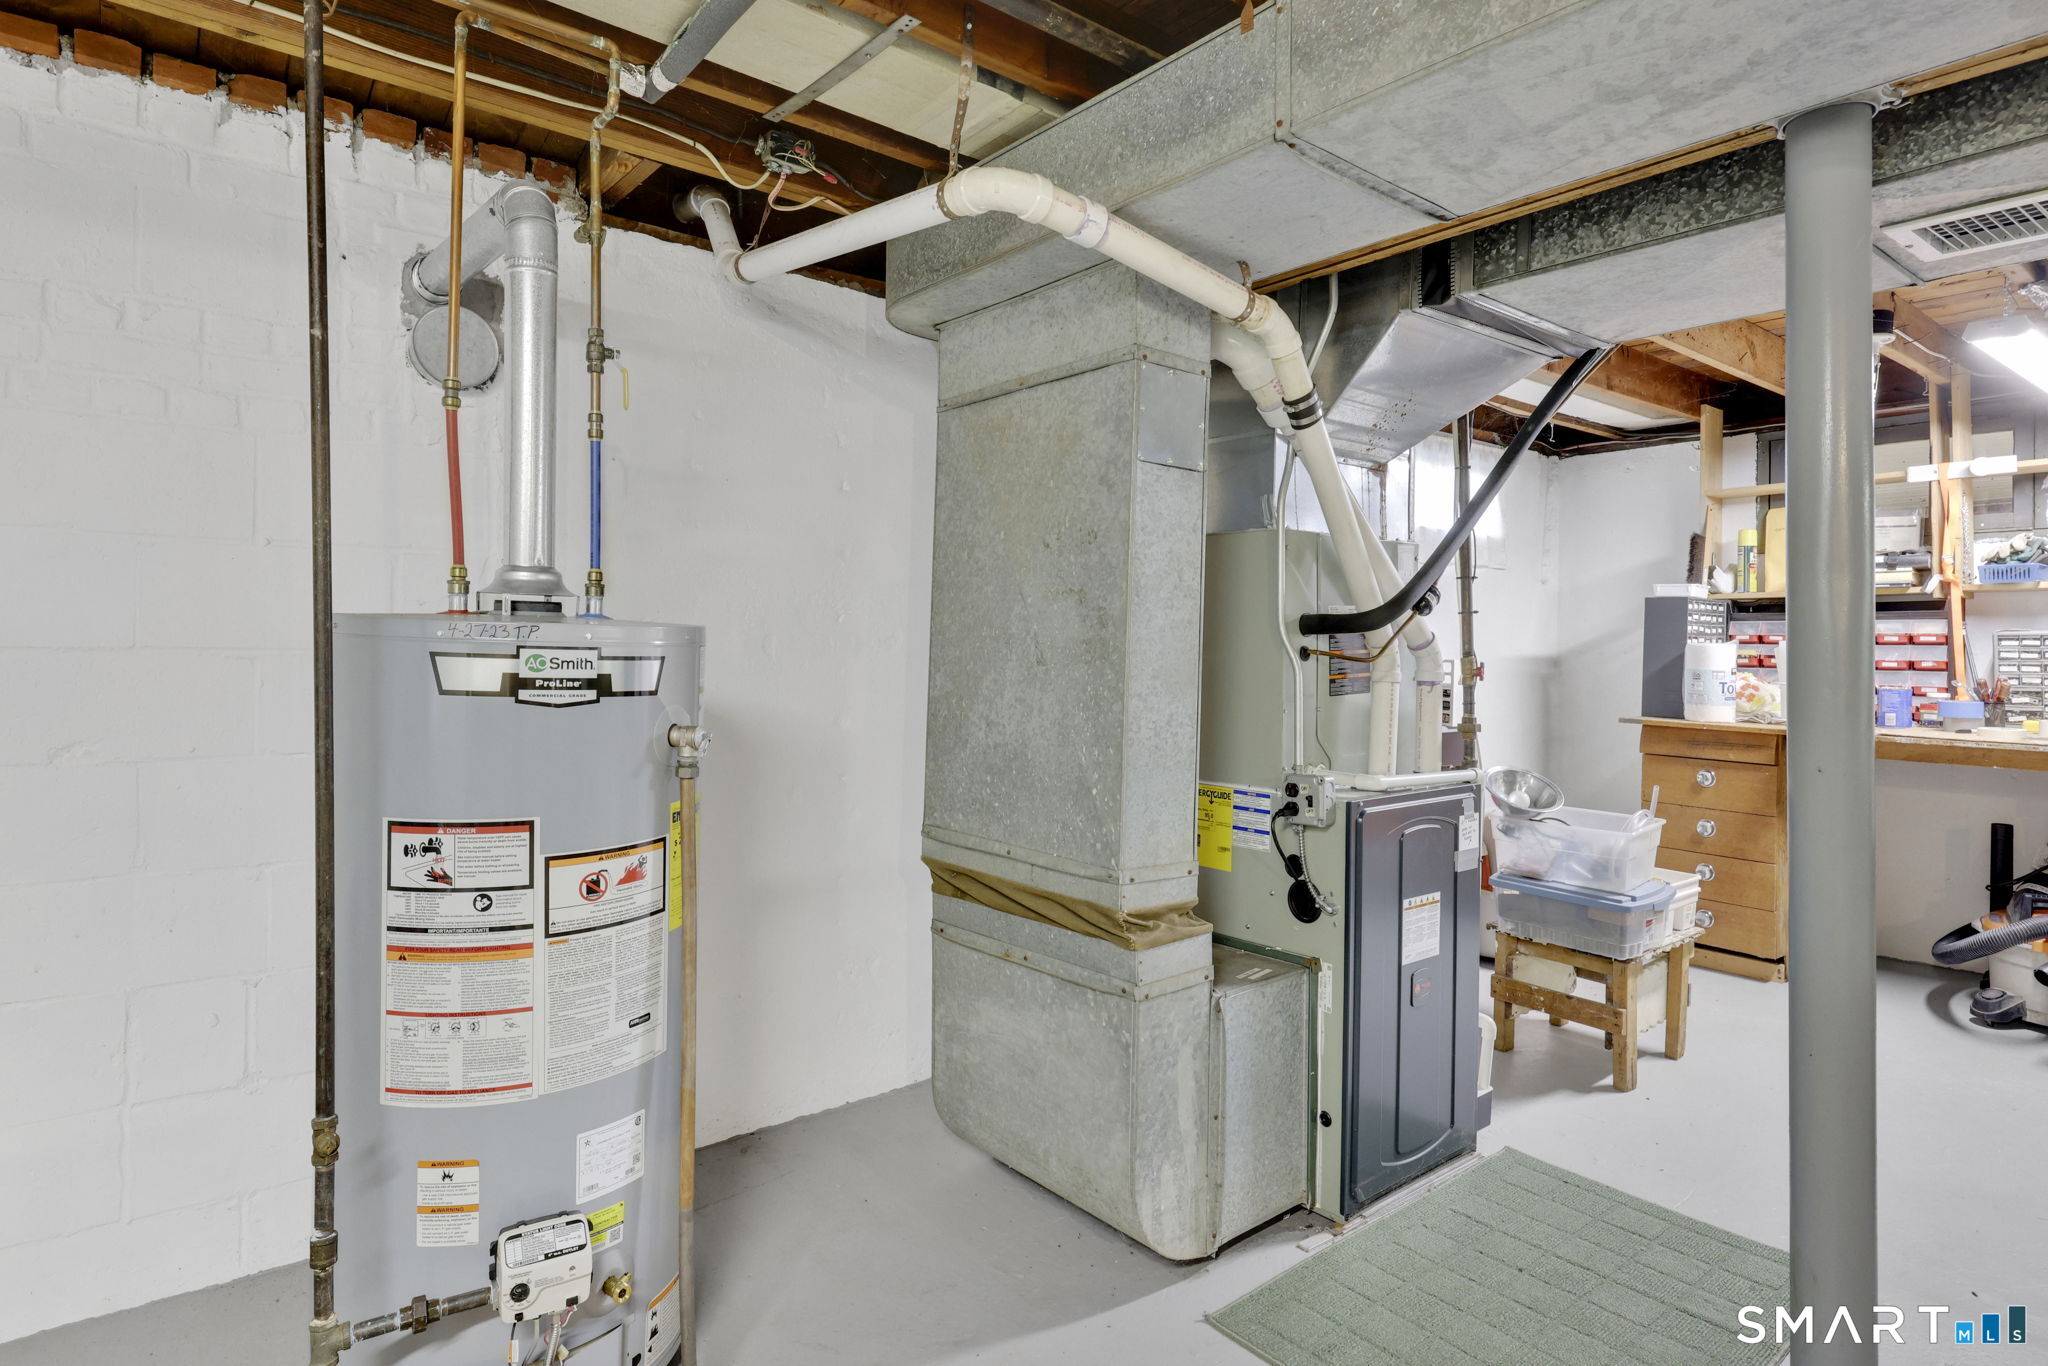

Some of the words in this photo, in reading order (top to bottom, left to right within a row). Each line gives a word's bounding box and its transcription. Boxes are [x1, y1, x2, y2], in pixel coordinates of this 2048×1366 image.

[535, 679, 582, 688] ProLine
[1198, 788, 1232, 801] ERGYGUIDE
[604, 850, 631, 860] WARNING
